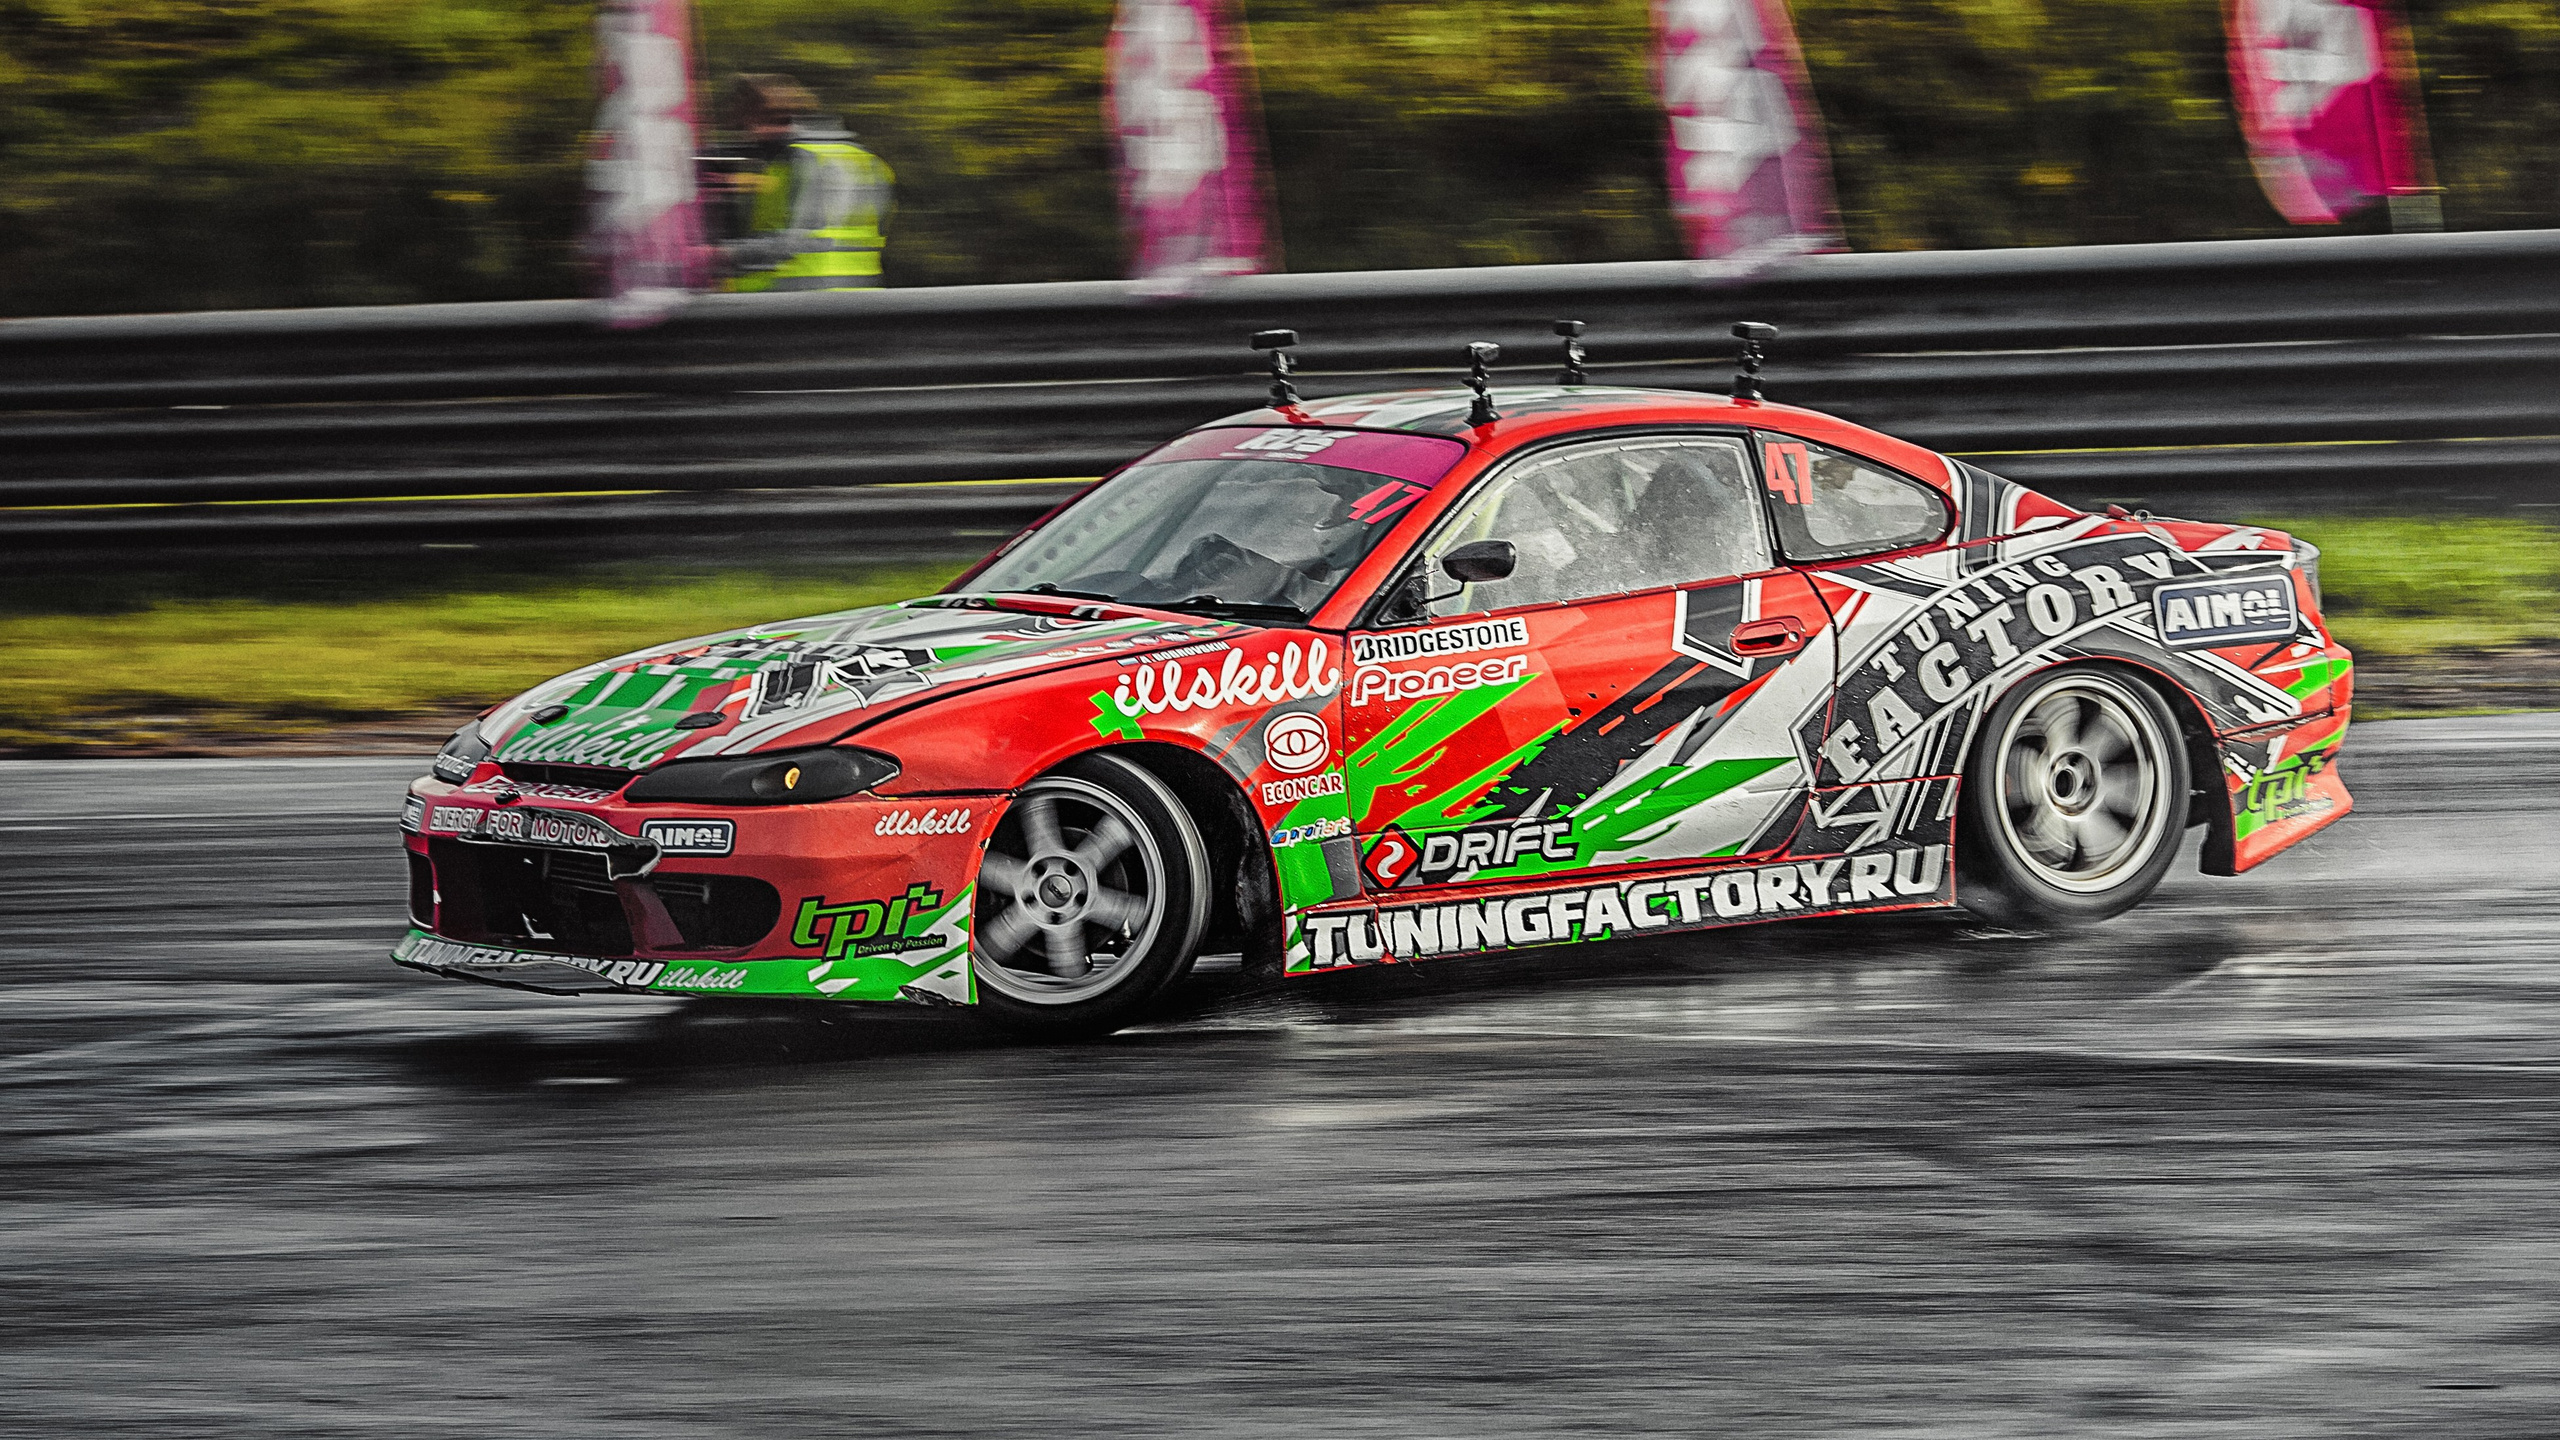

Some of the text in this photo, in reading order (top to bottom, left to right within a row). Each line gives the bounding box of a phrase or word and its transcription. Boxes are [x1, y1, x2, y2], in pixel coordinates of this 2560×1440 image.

[1765, 442, 1813, 505] 47
[1348, 480, 1430, 525] 47
[1869, 555, 2073, 683] TUNING
[2165, 589, 2290, 633] AIMOL
[1355, 621, 1523, 662] BRIDGESTONE
[1114, 637, 1341, 717] illskill
[1354, 659, 1522, 702] Pioneer
[1263, 773, 1344, 804] ECONCAR
[429, 806, 484, 833] ENERGY
[485, 809, 523, 838] FOR
[648, 827, 727, 847] AIMOL
[874, 807, 971, 836] illskill
[1420, 821, 1576, 873] DRIFT
[1305, 843, 1946, 966] TUNINGFACTORY.RU
[857, 937, 943, 954] Driven By Passion
[657, 966, 748, 989] illskill
